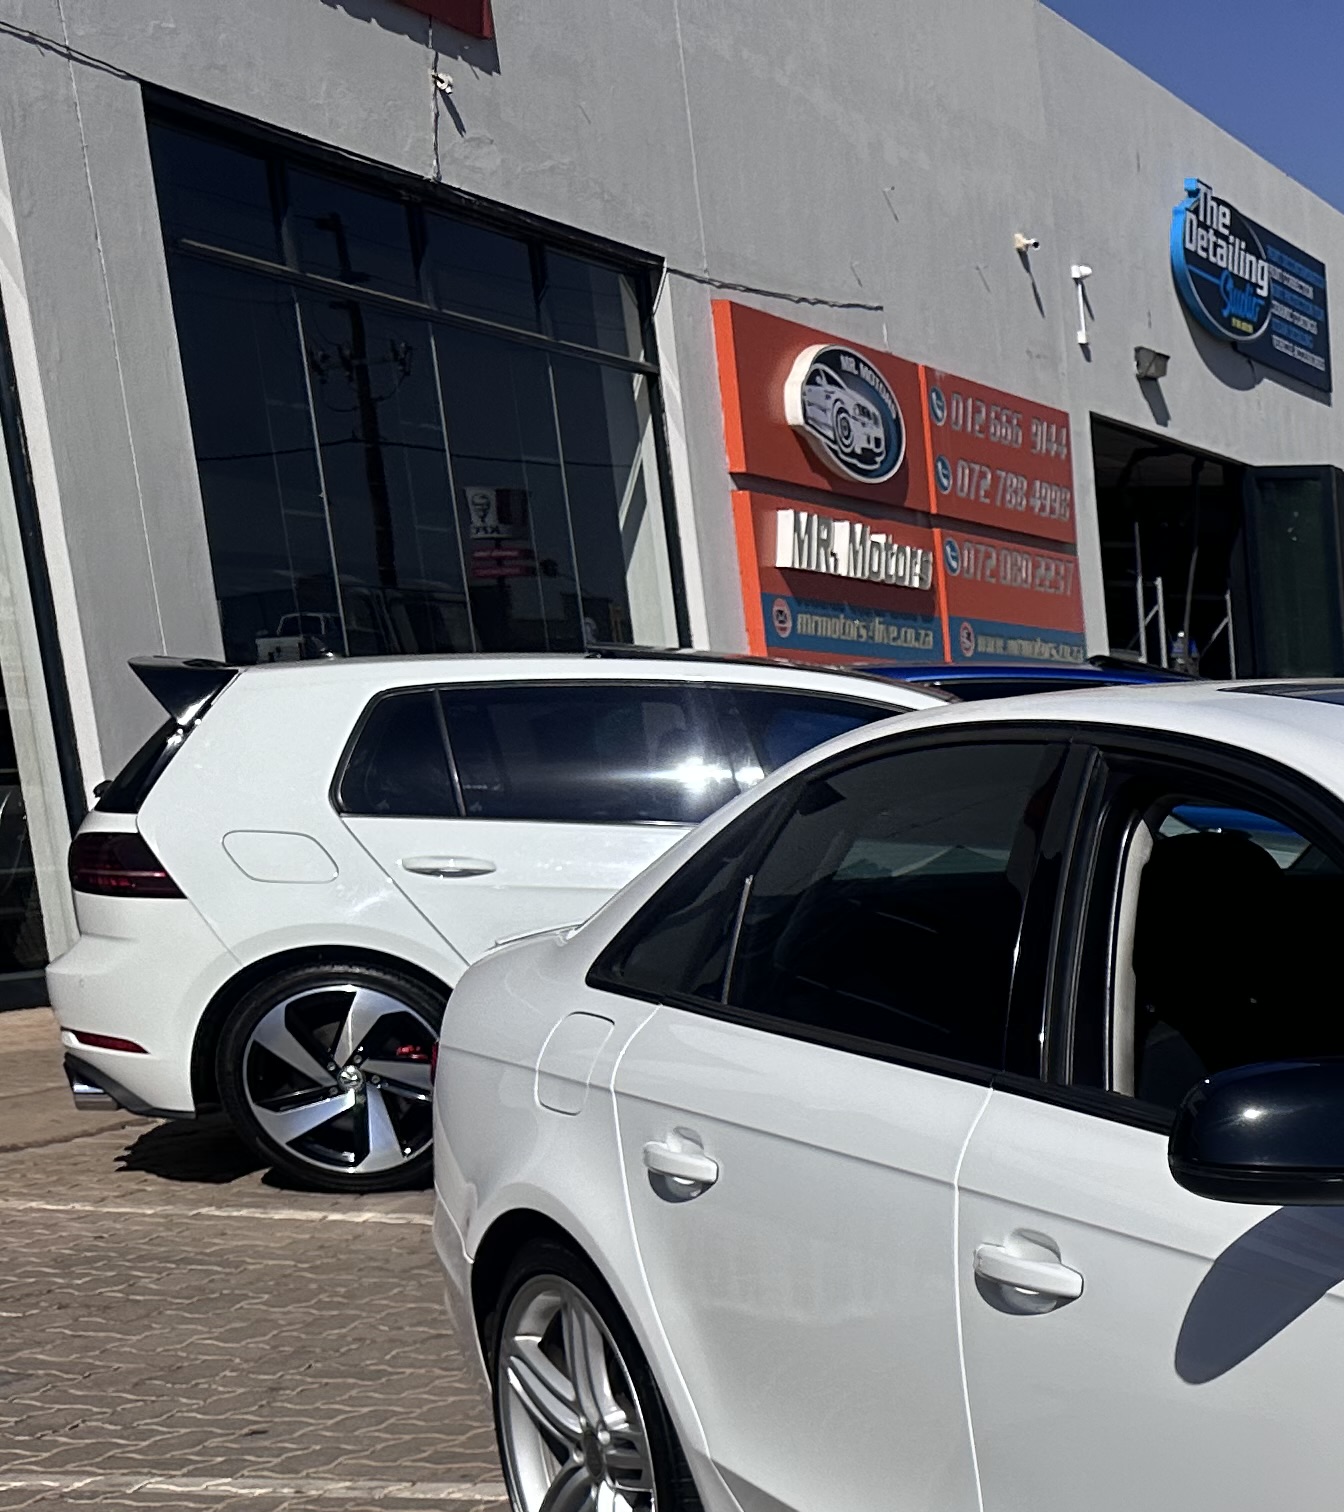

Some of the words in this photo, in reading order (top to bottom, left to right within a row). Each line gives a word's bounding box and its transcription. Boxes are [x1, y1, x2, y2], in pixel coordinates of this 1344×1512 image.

[1196, 180, 1231, 235] The
[1185, 211, 1269, 297] Detailing
[951, 393, 986, 438] 012
[989, 405, 1023, 448] 666
[1031, 416, 1067, 460] 9144
[956, 459, 991, 504] 072
[994, 469, 1027, 511] 788
[776, 509, 839, 575] MR.
[834, 520, 933, 590] Motors
[963, 541, 996, 583] 072
